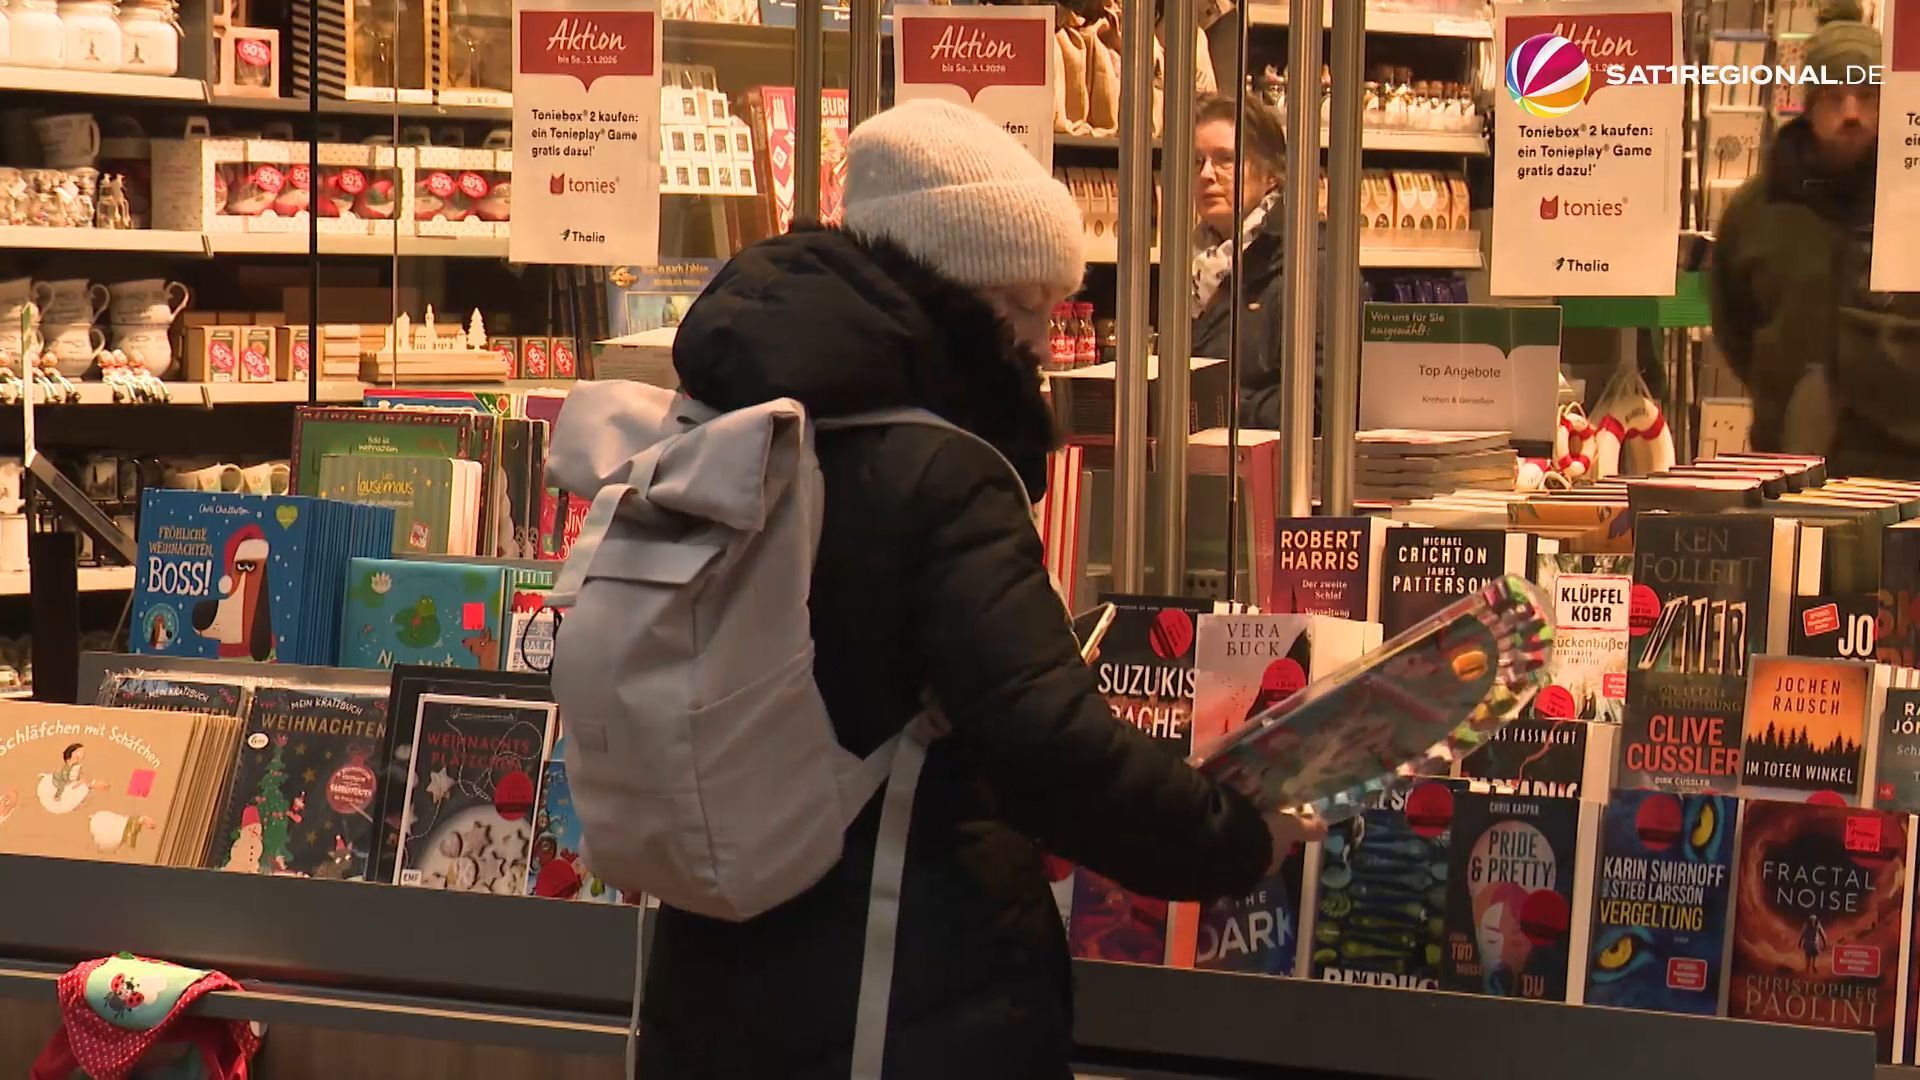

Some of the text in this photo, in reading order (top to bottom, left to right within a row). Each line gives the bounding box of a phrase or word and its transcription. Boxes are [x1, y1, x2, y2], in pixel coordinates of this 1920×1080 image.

[546, 18, 627, 51] Aktion
[930, 25, 1016, 60] Aktion
[586, 55, 618, 64] 3.1.2026
[972, 64, 1006, 73] 3.1.2026
[589, 112, 597, 122] 2
[598, 111, 639, 122] kaufen:
[531, 128, 547, 139] ein
[608, 129, 638, 140] Game
[1589, 126, 1598, 136] 2
[1601, 124, 1654, 137] kaufen:
[531, 146, 561, 159] gratis
[1517, 145, 1537, 157] ein
[1613, 145, 1653, 157] Game
[1517, 164, 1553, 179] gratis
[572, 231, 606, 244] Thalia
[1567, 259, 1609, 273] Thalia
[1371, 312, 1445, 322] Von uns für Sie
[1419, 364, 1501, 380] Top Angebote
[158, 525, 208, 541] FRÖHLICHE
[1280, 530, 1363, 549] ROBERT
[1423, 537, 1463, 547] MICHAEL
[1674, 527, 1729, 553] KEN
[1280, 551, 1361, 571] HARRIS
[1398, 546, 1488, 564] CRICHTON
[147, 556, 213, 596] BOSS!
[1427, 567, 1455, 576] JAMES
[1640, 553, 1762, 588] FOLLETT
[1302, 580, 1348, 589] Der zweite
[1392, 576, 1491, 594] PATTERSON
[1561, 583, 1624, 605] KLÜPFEL
[1571, 606, 1612, 623] KOBR
[1226, 623, 1281, 638] VERA
[1226, 641, 1280, 656] BUCK
[1775, 675, 1841, 696] JOCHEN
[290, 698, 363, 716] MEIN KRATZBUCH
[1773, 696, 1840, 716] RAUSCH
[261, 713, 387, 739] WEIHNACHTEN
[1649, 715, 1724, 745] CLIVE
[84, 723, 107, 737] mit
[109, 726, 161, 769] Schäfchen
[427, 732, 531, 755] WEIHNACHTS
[1514, 728, 1577, 745] FASSNACHT
[1626, 743, 1741, 775] CUSSLER
[1746, 760, 1854, 784] IM TOTEN WINKEL
[1655, 777, 1710, 787] DIRK CUSSLER
[1489, 802, 1540, 817] CHRIS KASPAR
[1489, 830, 1538, 858] PRIDE
[403, 873, 419, 882] EMF
[1471, 860, 1553, 887] & PRETTY
[1603, 856, 1725, 887] KARIN SMIRNOFF
[1762, 861, 1876, 890] FRACTAL
[1611, 880, 1646, 900] STIEG
[1648, 883, 1703, 905] LARSSON
[1777, 888, 1858, 913] NOISE
[1599, 900, 1703, 932] VERGELTUNG
[1197, 907, 1293, 963] DARK
[1522, 974, 1544, 996] DU
[1745, 975, 1878, 1003] CHRISTOPHER
[1744, 989, 1876, 1027] PAOLINI
